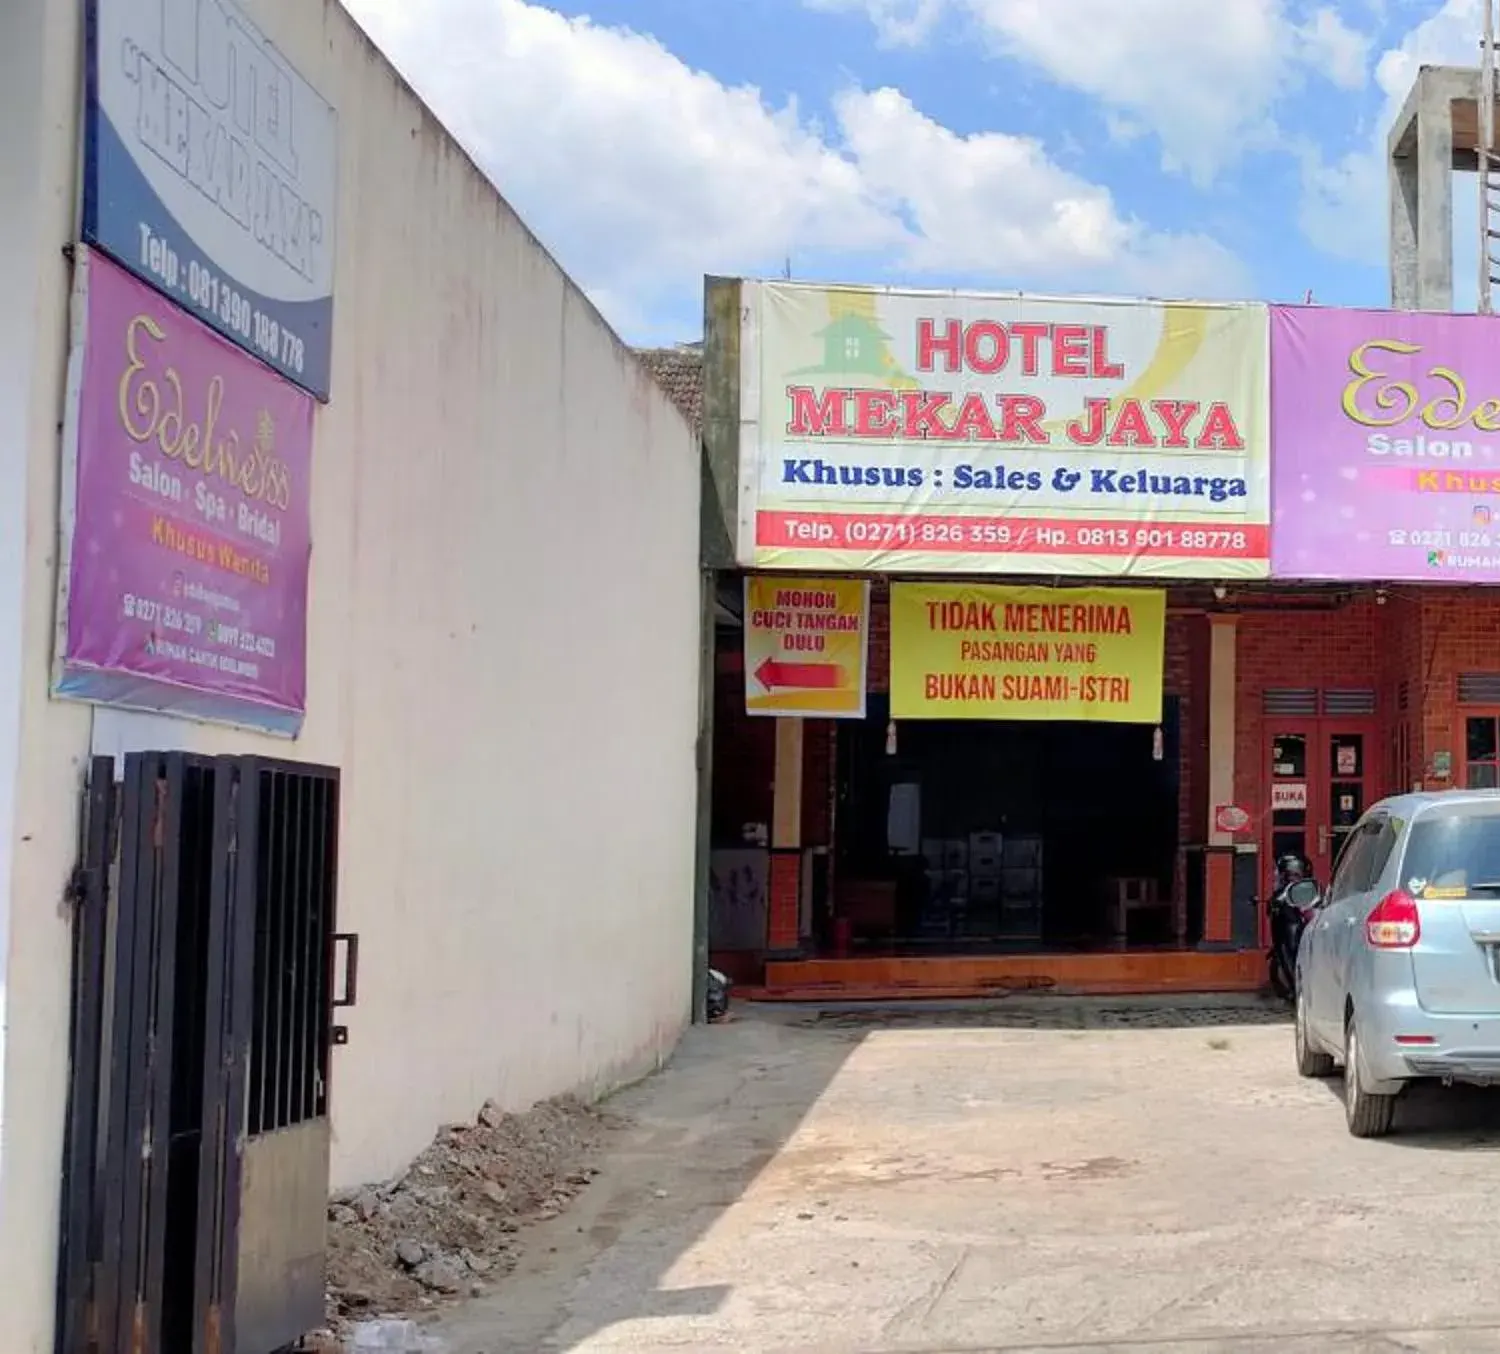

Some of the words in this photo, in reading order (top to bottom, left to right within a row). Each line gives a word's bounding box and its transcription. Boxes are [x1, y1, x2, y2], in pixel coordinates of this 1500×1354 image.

[139, 221, 179, 289] Telp
[188, 259, 220, 316] 081
[220, 282, 251, 338] 390
[915, 317, 1125, 380] HOTEL
[118, 313, 292, 513] Edelweiss
[785, 385, 1052, 445] MEKAR
[1065, 397, 1246, 450] JAYA
[1367, 433, 1473, 459] Salon
[782, 458, 924, 488] Khusus
[953, 464, 1041, 492] Sales
[1051, 471, 1081, 493] &
[1090, 468, 1248, 503] Keluarga
[129, 451, 182, 502] Salon
[195, 480, 226, 522] Spa
[238, 501, 281, 546] Bridal
[152, 514, 216, 563] Khusus
[218, 542, 270, 585] Wanita
[785, 519, 837, 541] Telp.
[845, 522, 915, 544] (0271)
[922, 525, 962, 543] 826
[969, 527, 1010, 545] 359
[1036, 531, 1070, 551] Hp.
[1078, 530, 1128, 546] 0813
[1135, 531, 1173, 548] 901
[1181, 532, 1246, 551] 88778
[776, 590, 837, 609] MOHON
[752, 610, 792, 628] CUCI
[928, 601, 998, 632] TIDAK
[1006, 603, 1132, 634] MENERIMA
[961, 641, 1049, 662] PASANGAN
[1054, 643, 1096, 663] YANG
[925, 674, 996, 700] BUKAN
[1002, 675, 1130, 702] SUAMI-ISTRI
[1274, 791, 1305, 802] BUKA
